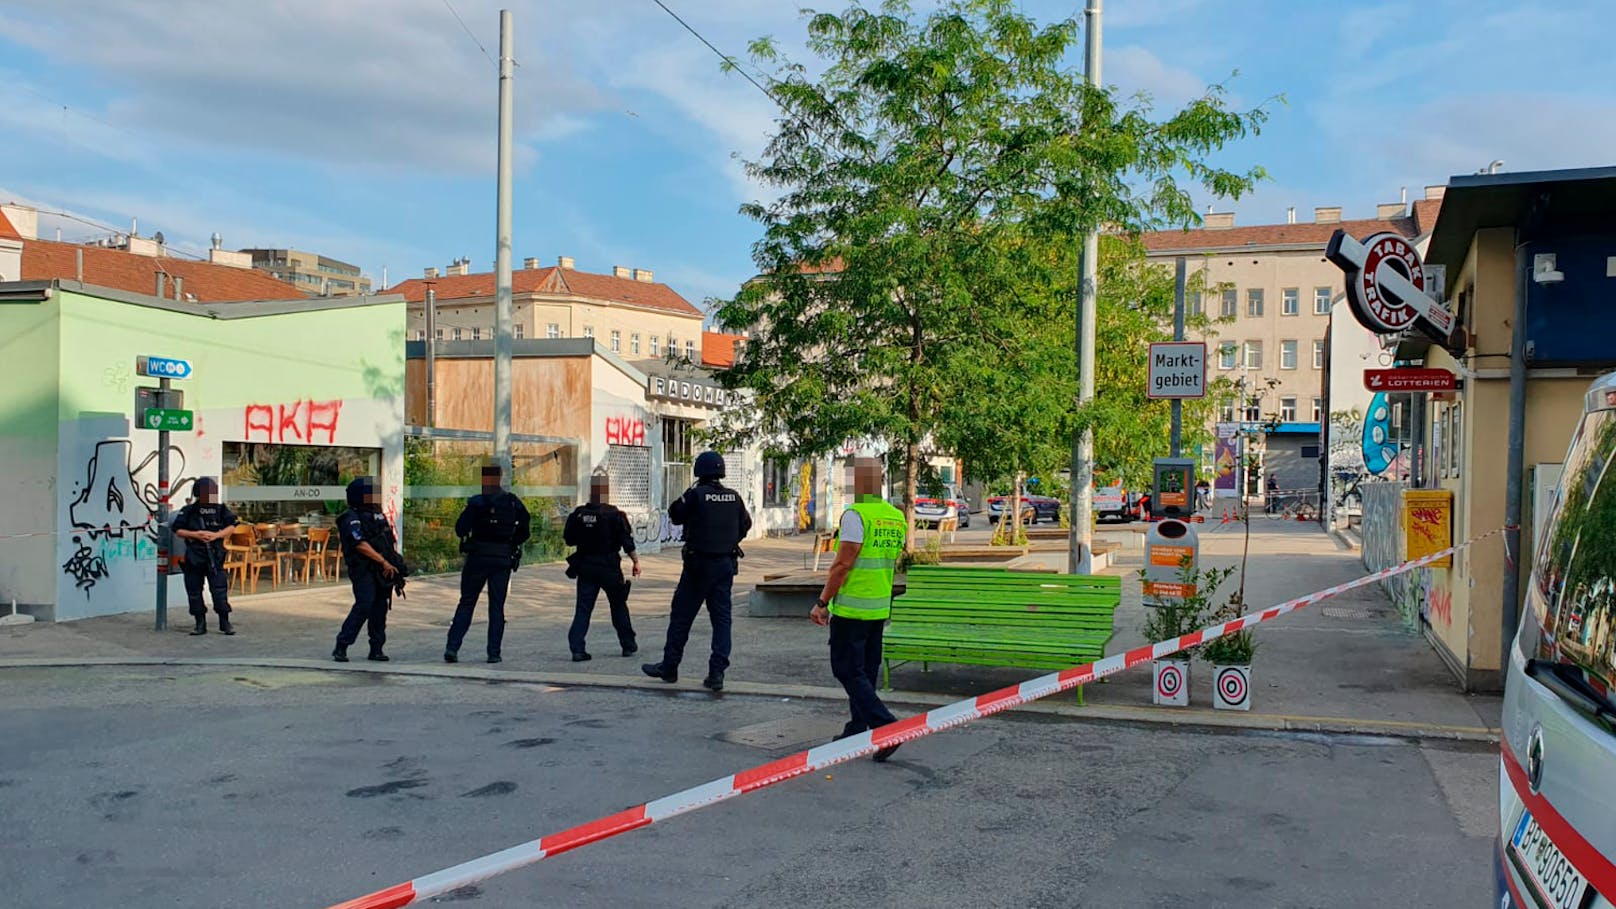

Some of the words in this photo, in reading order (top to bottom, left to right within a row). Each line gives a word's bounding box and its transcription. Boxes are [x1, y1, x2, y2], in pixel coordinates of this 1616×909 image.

[1374, 240, 1422, 280] TABAK
[1364, 271, 1409, 323] TRAFIK
[150, 360, 166, 373] WC
[1156, 353, 1200, 367] Markt-
[1155, 373, 1200, 389] gebiet
[245, 398, 343, 444] AKA
[605, 415, 646, 447] AKA
[705, 493, 736, 502] POLIZEI
[1521, 818, 1541, 856] BP
[1537, 841, 1580, 909] 90650
